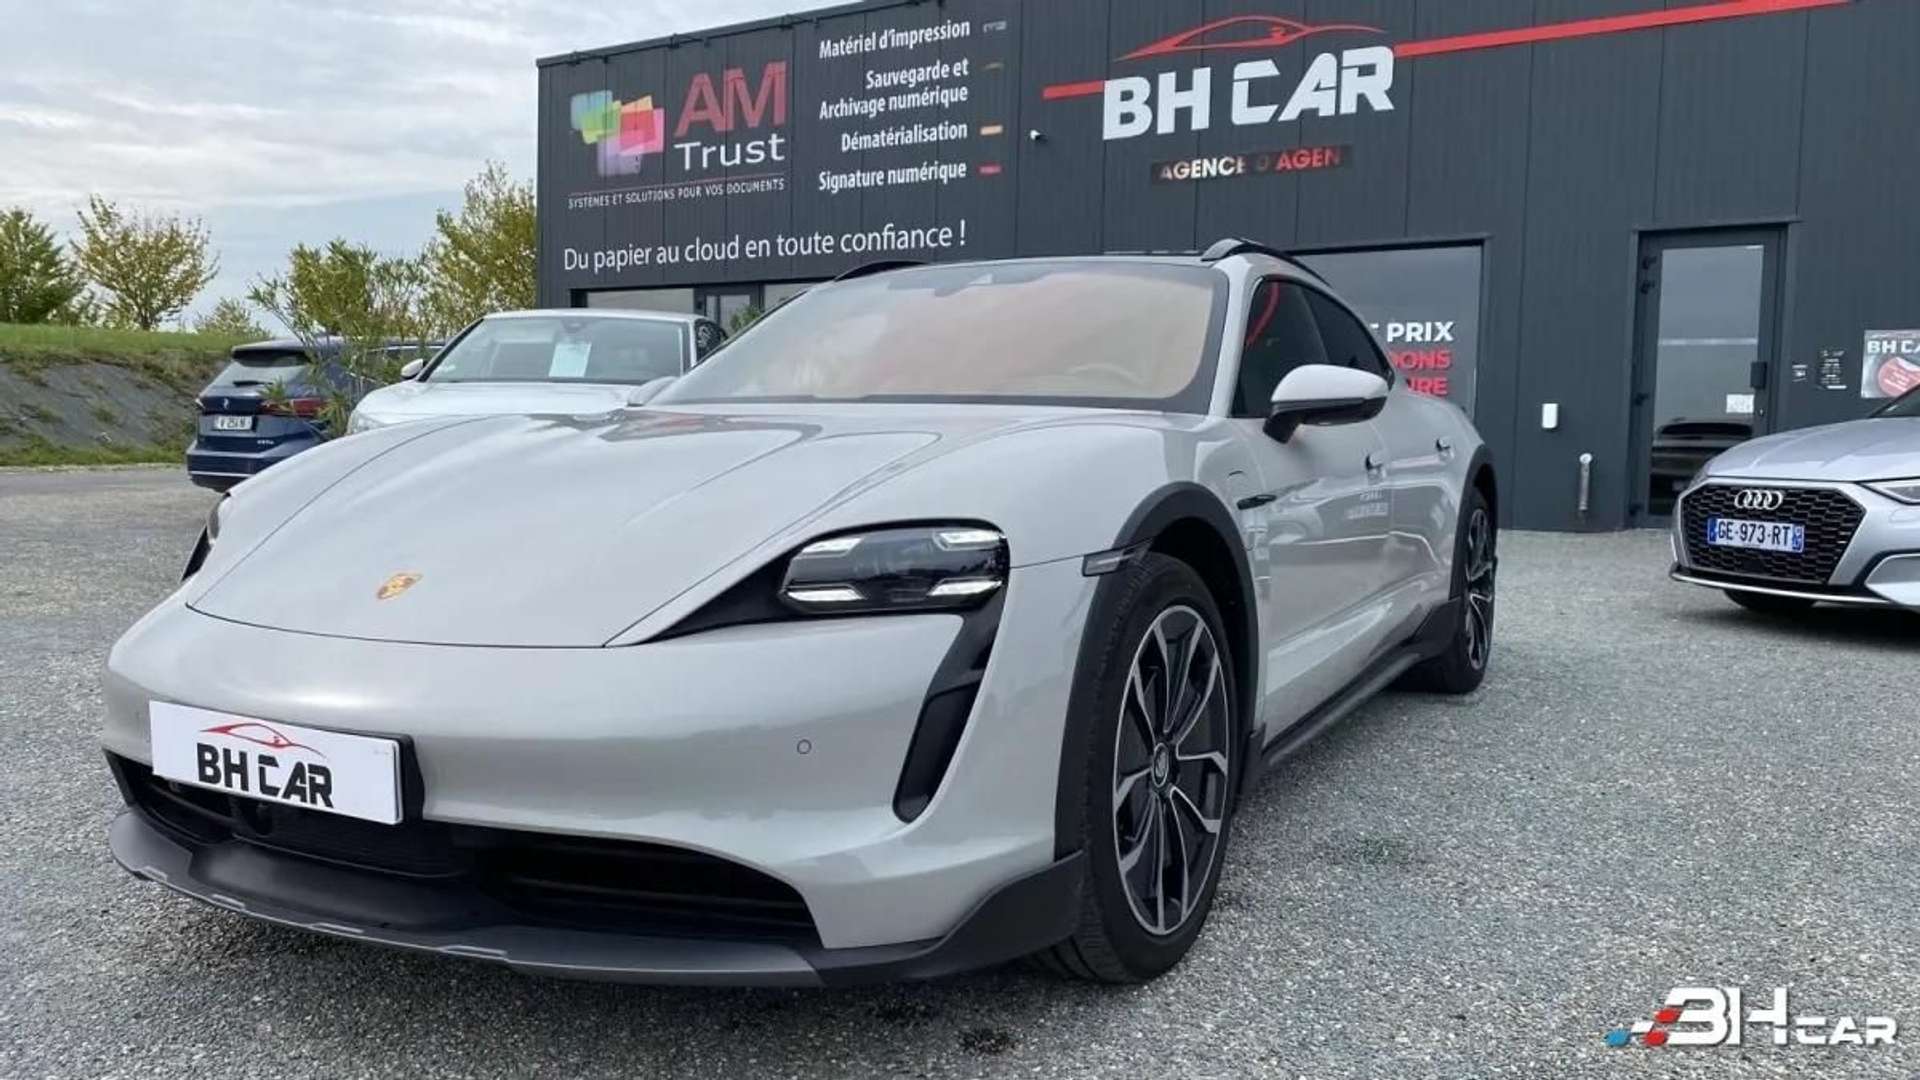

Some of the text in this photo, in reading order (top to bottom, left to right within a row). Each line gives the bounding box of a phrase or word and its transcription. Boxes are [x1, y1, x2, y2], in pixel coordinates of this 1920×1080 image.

[819, 31, 876, 59] Matériel
[879, 20, 970, 49] d'impression
[866, 58, 969, 89] Sauvegarde et
[674, 60, 786, 138] AM
[819, 86, 968, 119] Archivage numérique
[1102, 46, 1394, 140] BH CAR
[674, 133, 785, 171] Trust
[841, 121, 968, 152] Dématérialisation
[612, 192, 622, 206] ET
[625, 188, 675, 203] SOLUTIONS
[678, 185, 701, 198] POUR
[706, 182, 724, 196] VOS
[727, 178, 784, 195] DOCUMENTS
[819, 161, 967, 194] Signature numérique
[564, 219, 966, 274] Du papier au cloud en toute confiance !
[1387, 322, 1454, 342] PRIX
[1867, 340, 1897, 354] BH
[1718, 521, 1791, 547] GE-973-RT
[197, 743, 334, 809] BH CAR
